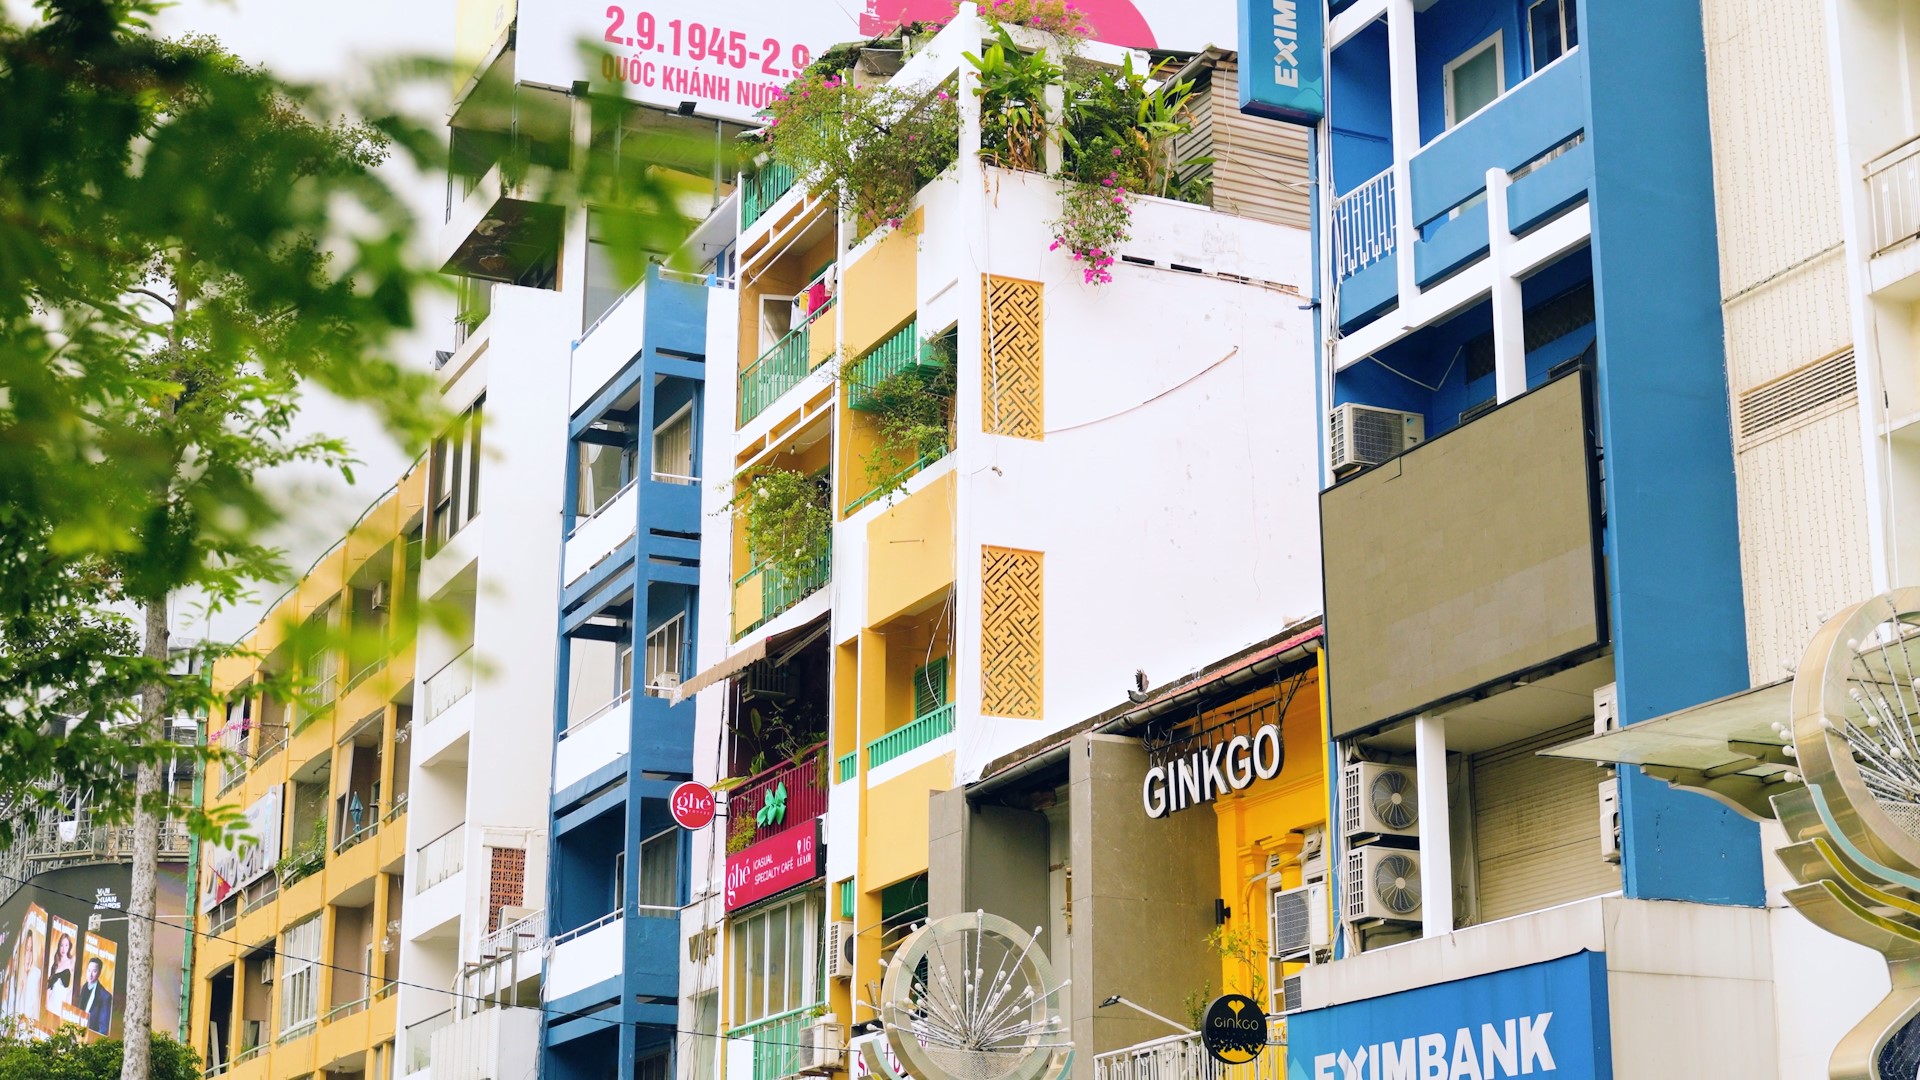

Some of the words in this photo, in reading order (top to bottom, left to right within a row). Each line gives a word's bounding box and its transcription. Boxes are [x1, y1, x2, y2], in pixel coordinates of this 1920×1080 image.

[602, 51, 655, 87] QUỐC
[662, 66, 730, 102] KHÁNH
[1143, 723, 1281, 820] GINKGO
[803, 836, 811, 852] 16
[754, 854, 773, 870] CASUAL
[781, 856, 794, 873] CAFÉ
